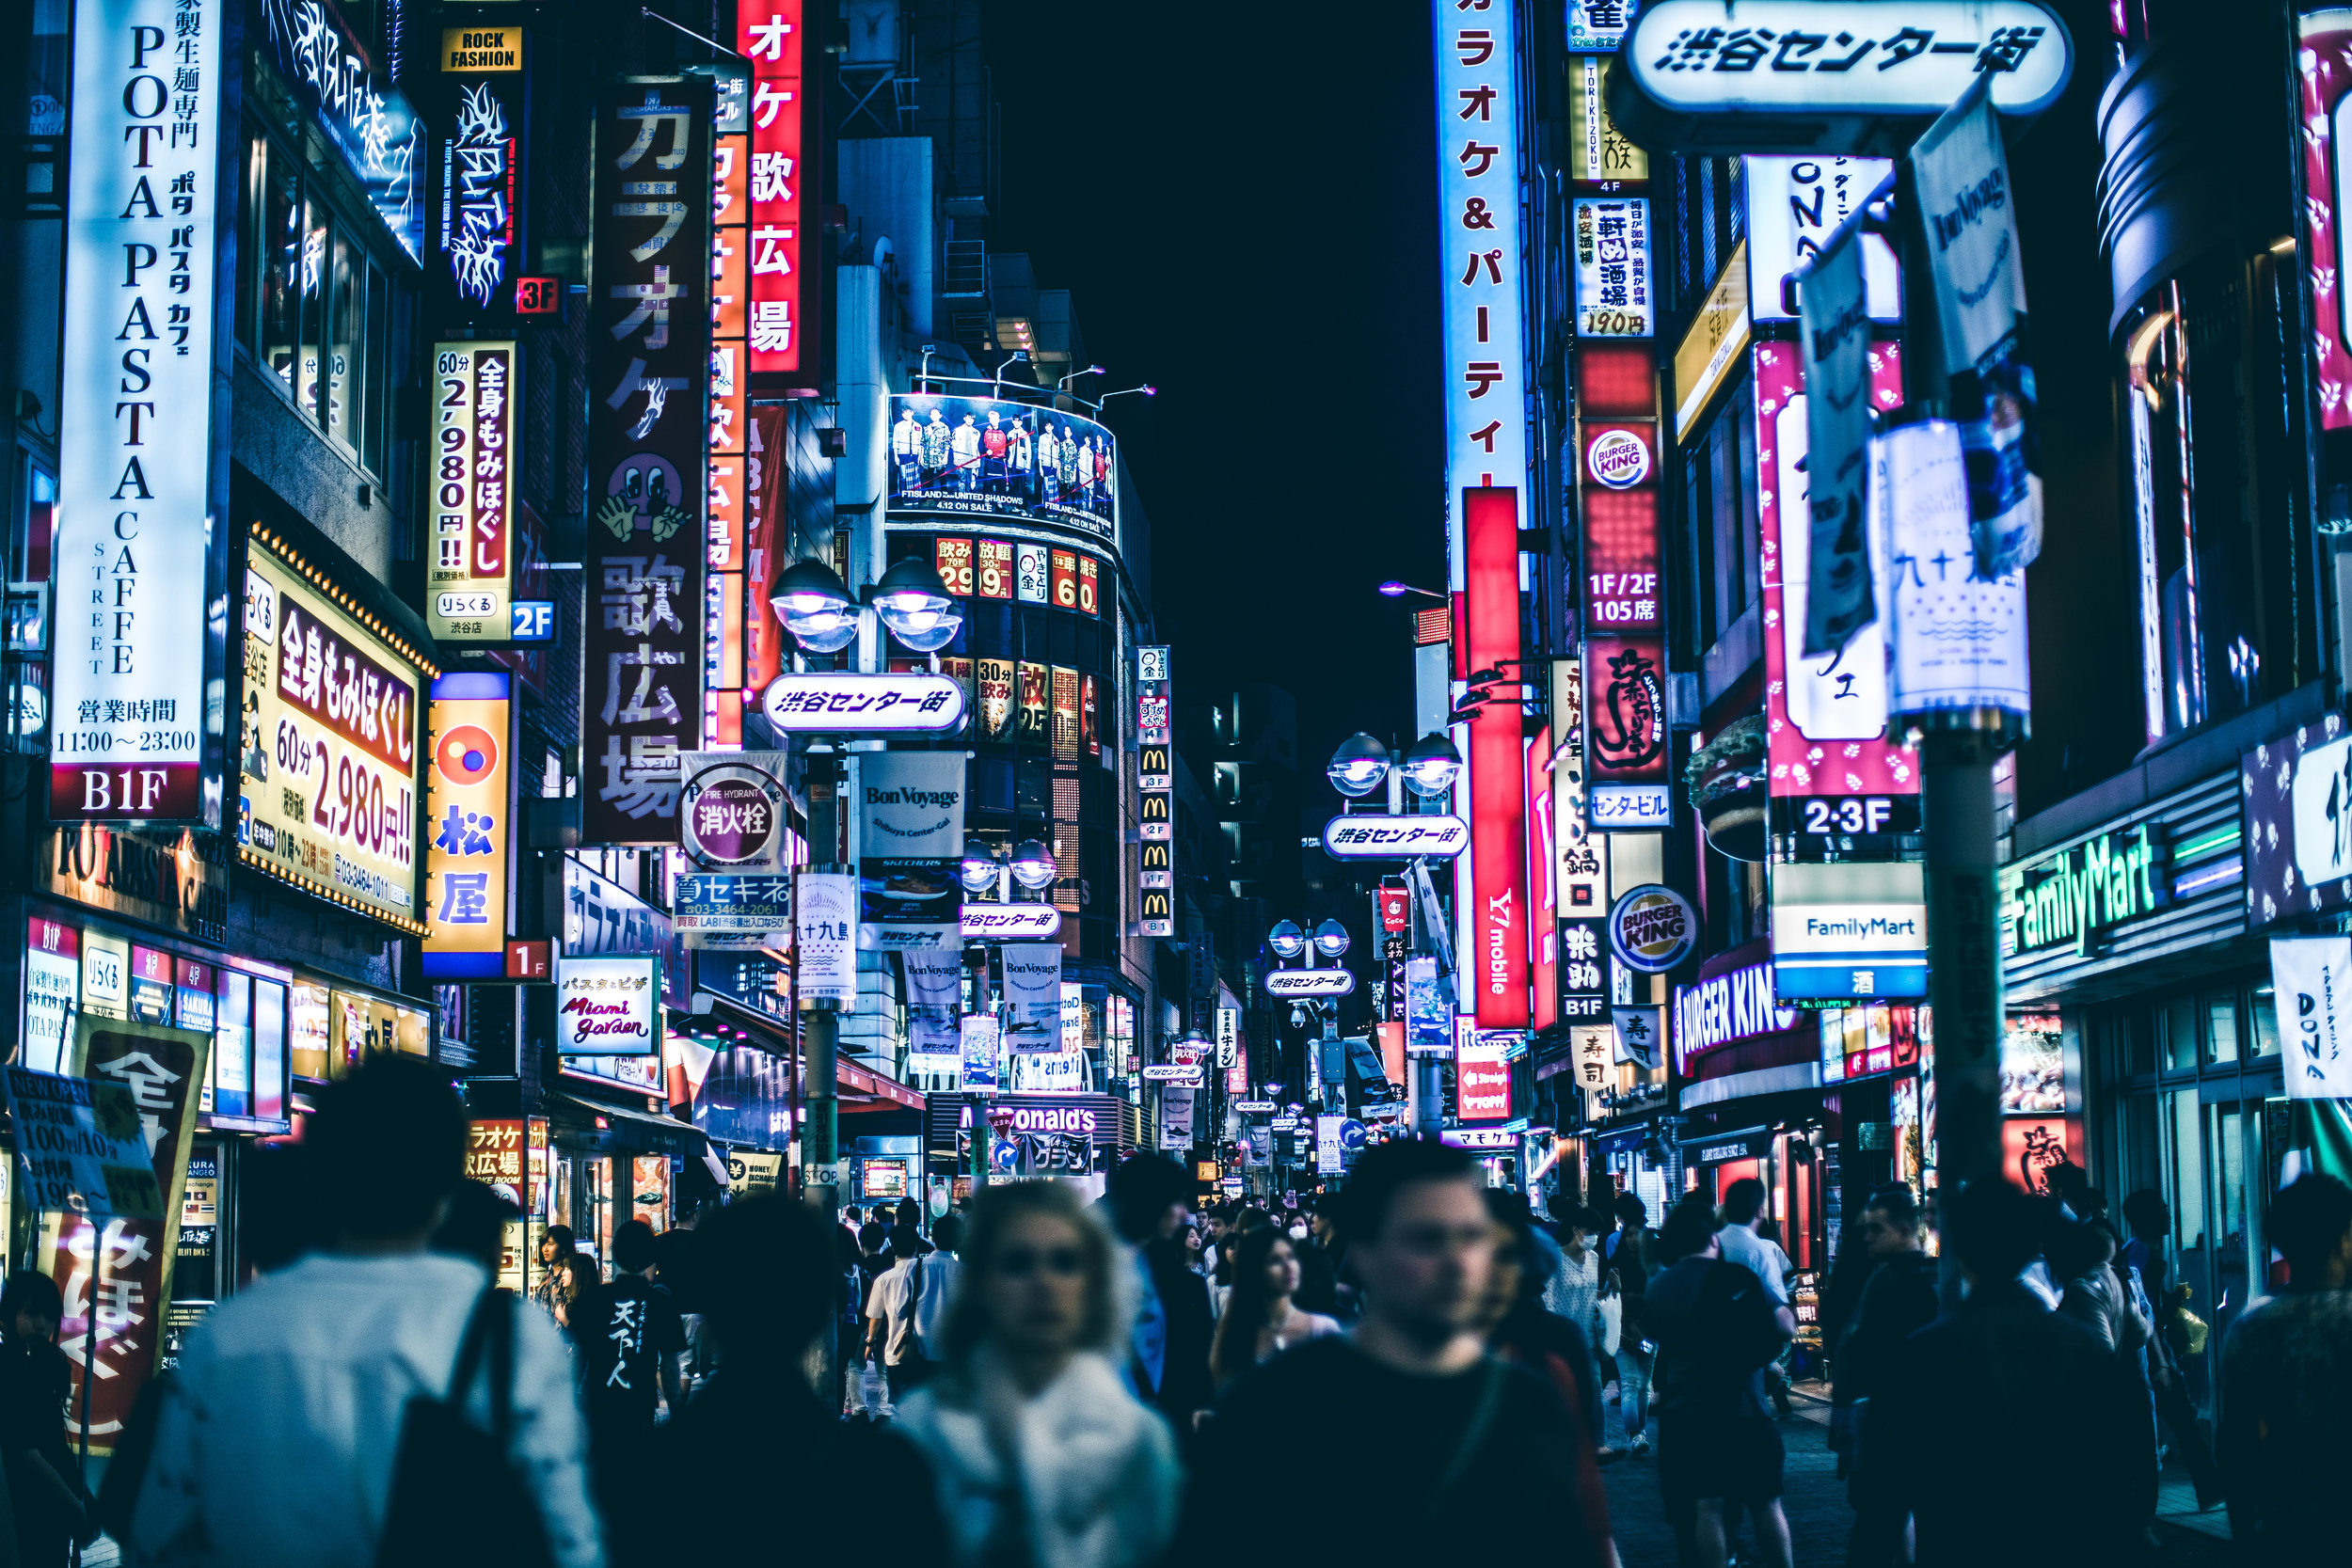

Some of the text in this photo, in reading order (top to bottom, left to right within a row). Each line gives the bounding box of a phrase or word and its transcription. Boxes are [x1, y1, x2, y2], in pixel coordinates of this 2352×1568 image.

[462, 33, 504, 49] ROCK
[1654, 25, 2047, 73] 渋谷センター街
[451, 51, 515, 68] FASHION
[1587, 67, 1598, 165] TORIKIZOKU
[444, 146, 453, 164] KEEPS
[443, 188, 452, 199] THE
[1600, 182, 1620, 192] 4F
[442, 200, 451, 221] LEGEND
[441, 230, 450, 248] ROCK
[1578, 205, 1594, 264] 激安酒場
[167, 172, 196, 356] ポタ パスタ カフェ
[605, 88, 691, 443] カラオケ
[1597, 203, 1629, 307] 一軒め酒場
[522, 281, 553, 310] 3F
[1586, 310, 1645, 335] 190円
[109, 25, 168, 674] POTA PASTA CAFFE
[437, 352, 469, 374] 60分
[1598, 441, 1639, 463] BURGER
[1600, 451, 1641, 476] KING
[476, 357, 506, 572] 全身もみほぐし
[901, 490, 1024, 506] FTISLAND UNITED SHADOWS
[936, 501, 993, 513] 4.12 ON SALE
[1044, 501, 1073, 515] FTISLAND
[1069, 517, 1101, 533] 4.12 ON SALE
[938, 541, 972, 558] 飲み
[1021, 576, 1035, 591] 金
[1036, 548, 1046, 599] やきとり
[1589, 573, 1657, 595] 1F/2F
[89, 542, 106, 675] STREET
[247, 580, 273, 629] らくる
[443, 597, 491, 612] りらくる
[1592, 600, 1656, 622] 105席
[451, 622, 483, 635] 渋谷店
[513, 607, 551, 636] 2F
[979, 662, 1012, 681] 30分
[280, 610, 412, 764] 全身もみほぐし
[599, 553, 687, 820] 歌広場
[979, 681, 1012, 700] 飲み
[77, 699, 177, 724] 営業時間
[774, 690, 953, 713] 渋谷センター街
[277, 717, 312, 776] 60分
[81, 770, 168, 811] B1F
[706, 789, 722, 799] FIRE
[723, 788, 759, 799] HYDRANT
[1148, 778, 1164, 786] 3F
[866, 786, 960, 809] Bon Voyage
[1592, 795, 1668, 817] センタービル
[700, 802, 767, 836] 消火栓
[872, 817, 951, 838] Shibuya Center-Gai
[1148, 826, 1164, 834] 2F
[1334, 827, 1462, 844] 渋谷センター街
[435, 804, 495, 926] 松屋
[342, 860, 389, 903] 03-3464-1011
[1149, 874, 1164, 882] 1F
[2010, 821, 2155, 958] FamilyMart
[704, 876, 790, 904] セキネ
[694, 904, 779, 915] 03-3464-2061
[961, 912, 1053, 927] 渋谷センター街
[1623, 903, 1683, 932] BURGER
[676, 916, 698, 927] 買取
[1150, 922, 1166, 930] B1
[1806, 917, 1915, 941] FamilyMart
[42, 924, 61, 952] B1F
[880, 931, 944, 941] 渋谷センター街
[1489, 887, 1512, 995] Y!mobile
[1626, 918, 1686, 950] KING
[516, 945, 545, 975] 1F
[1006, 962, 1058, 975] Bon Voyage
[1564, 924, 1601, 990] 米助
[89, 958, 119, 990] りらくる
[908, 964, 960, 978] Bon Voyage
[1270, 976, 1349, 989] 渋谷センター街
[562, 976, 648, 991] パスタとピザ
[1851, 971, 1875, 995] 酒
[183, 993, 214, 1018] SAKURA
[561, 996, 630, 1017] Miami
[1565, 1000, 1603, 1016] B1F
[1682, 974, 1732, 1054] BURGER
[1220, 1034, 1234, 1067] 牛タン
[1626, 1015, 1651, 1066] 寿司
[1582, 1036, 1605, 1084] 寿司
[14, 1075, 90, 1105] NEW OPEN
[961, 1106, 1097, 1132] Donald's
[993, 1118, 1010, 1127] 止まれ
[470, 1125, 522, 1149] ラオケ
[188, 1161, 215, 1169] KURA
[495, 1176, 521, 1185] ROOM
[748, 1174, 778, 1182] EXCHANGE
[60, 1052, 183, 1434] 全みほぐし
[606, 1300, 637, 1390] 天下人
